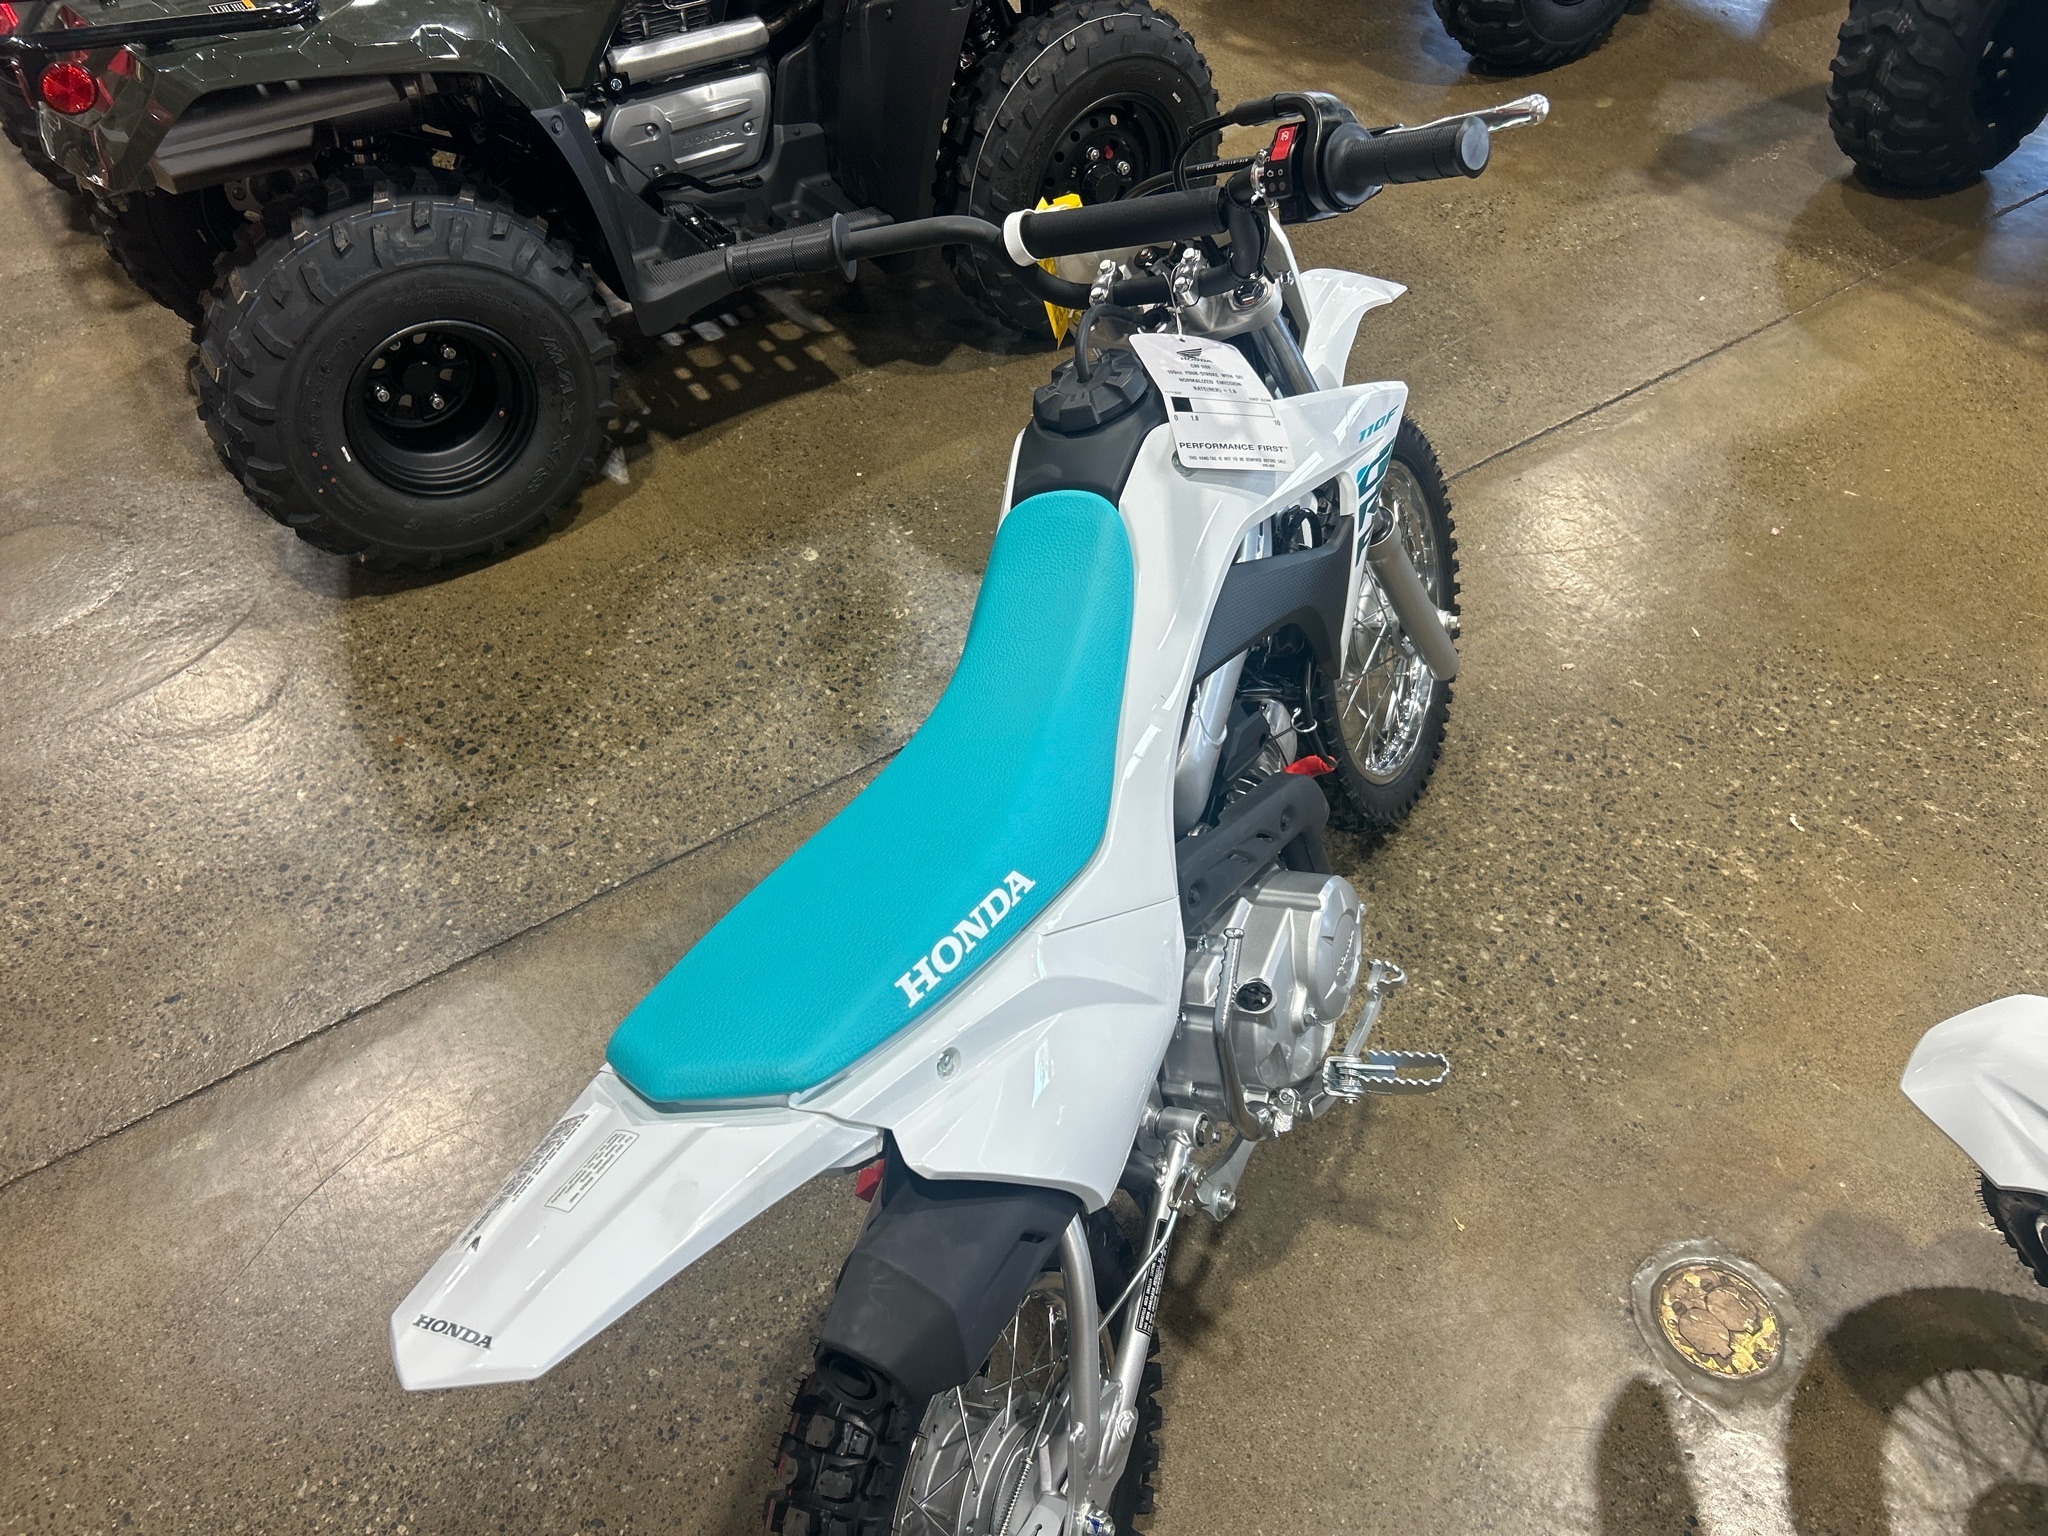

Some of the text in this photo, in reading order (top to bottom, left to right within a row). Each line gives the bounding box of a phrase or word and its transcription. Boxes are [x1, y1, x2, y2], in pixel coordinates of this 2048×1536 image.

[527, 337, 576, 494] MAXXIS
[1358, 404, 1400, 443] 110F
[1179, 442, 1254, 451] PERFORMANCE
[894, 870, 1037, 1008] HONDA
[412, 1313, 493, 1350] HONDA
